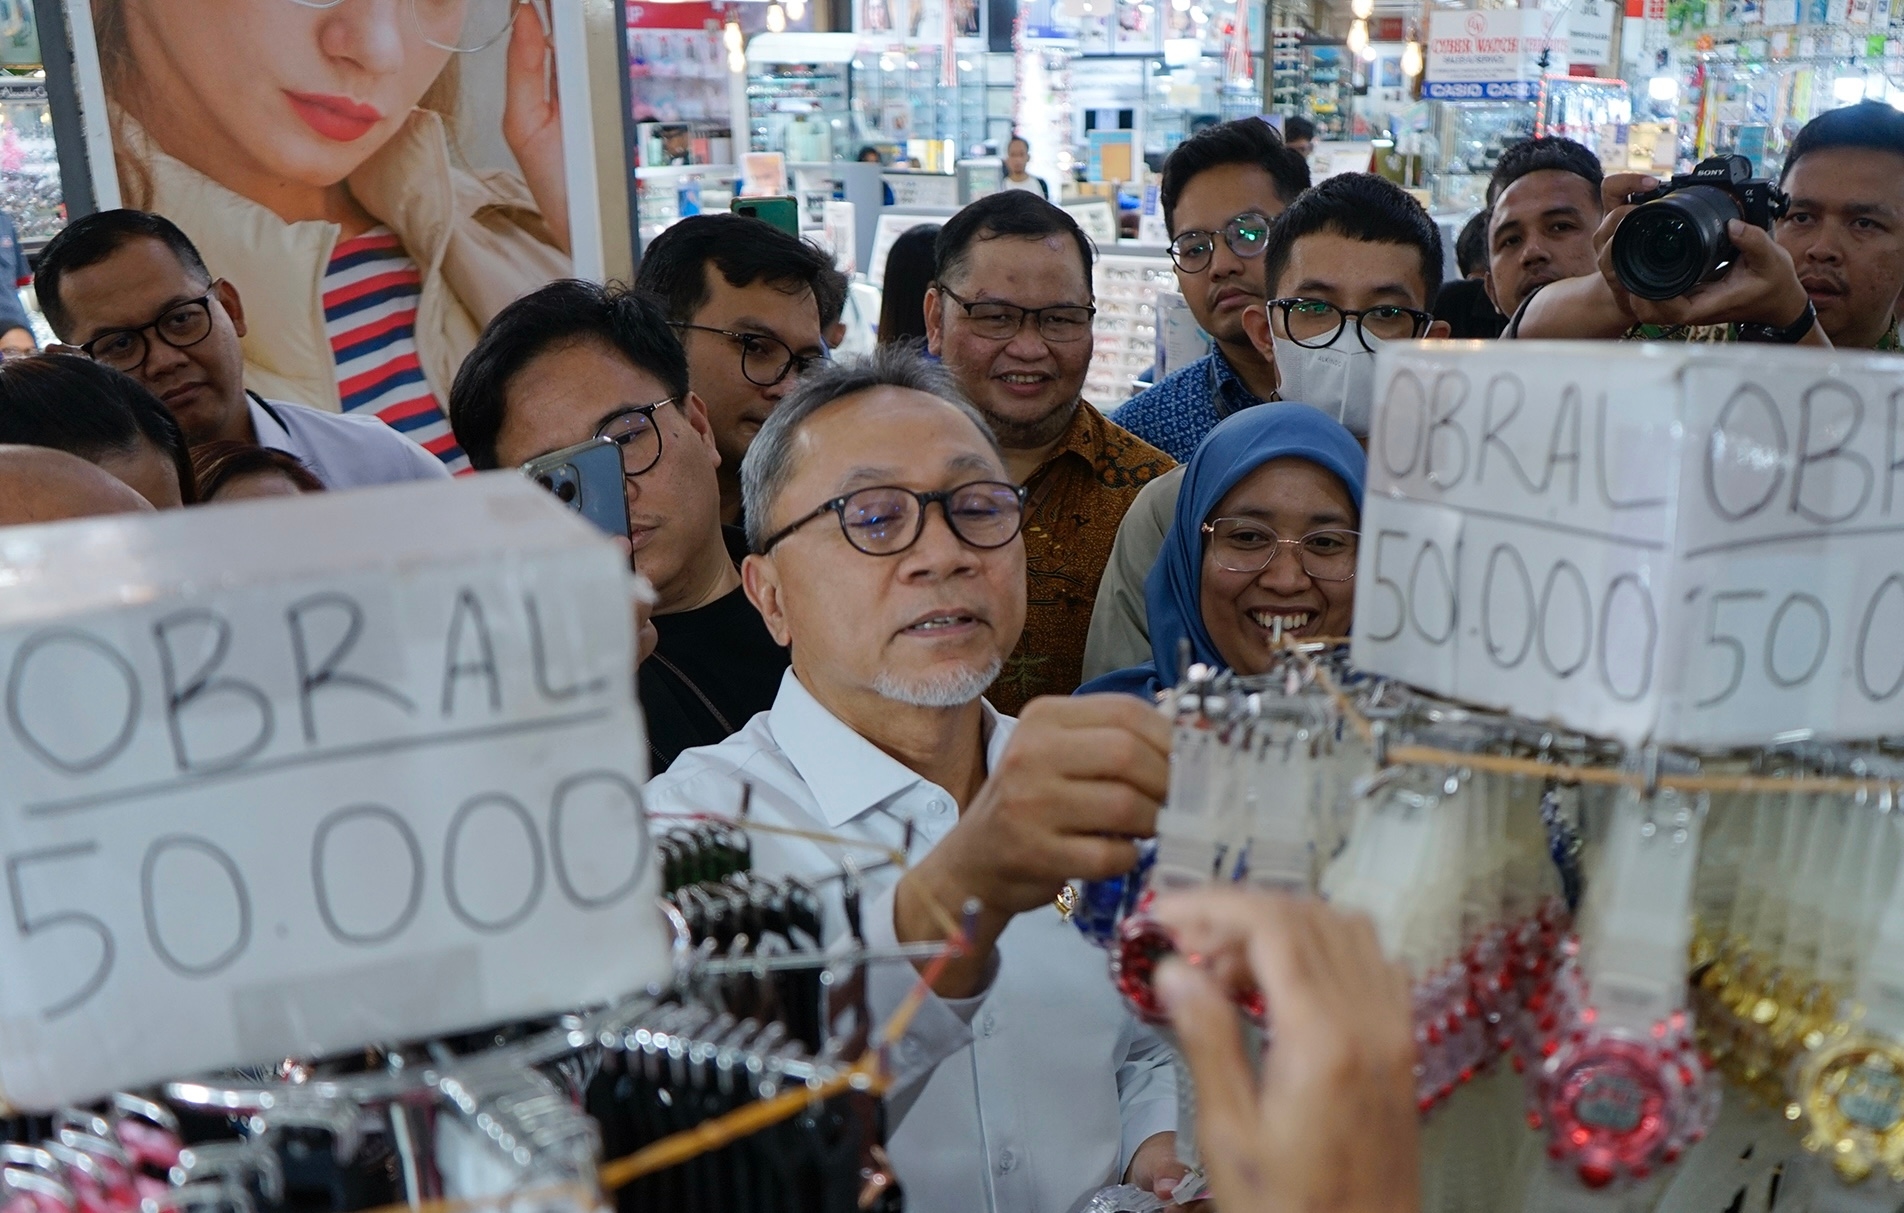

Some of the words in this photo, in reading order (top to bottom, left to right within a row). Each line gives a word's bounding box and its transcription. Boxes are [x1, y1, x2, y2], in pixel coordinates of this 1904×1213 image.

[1430, 83, 1483, 97] CASIO
[1697, 168, 1726, 176] SONY
[1379, 368, 1667, 509] OBRAL
[6, 588, 612, 778] OBRAL
[1367, 529, 1659, 702] 50.000
[5, 769, 652, 1020] 50.000
